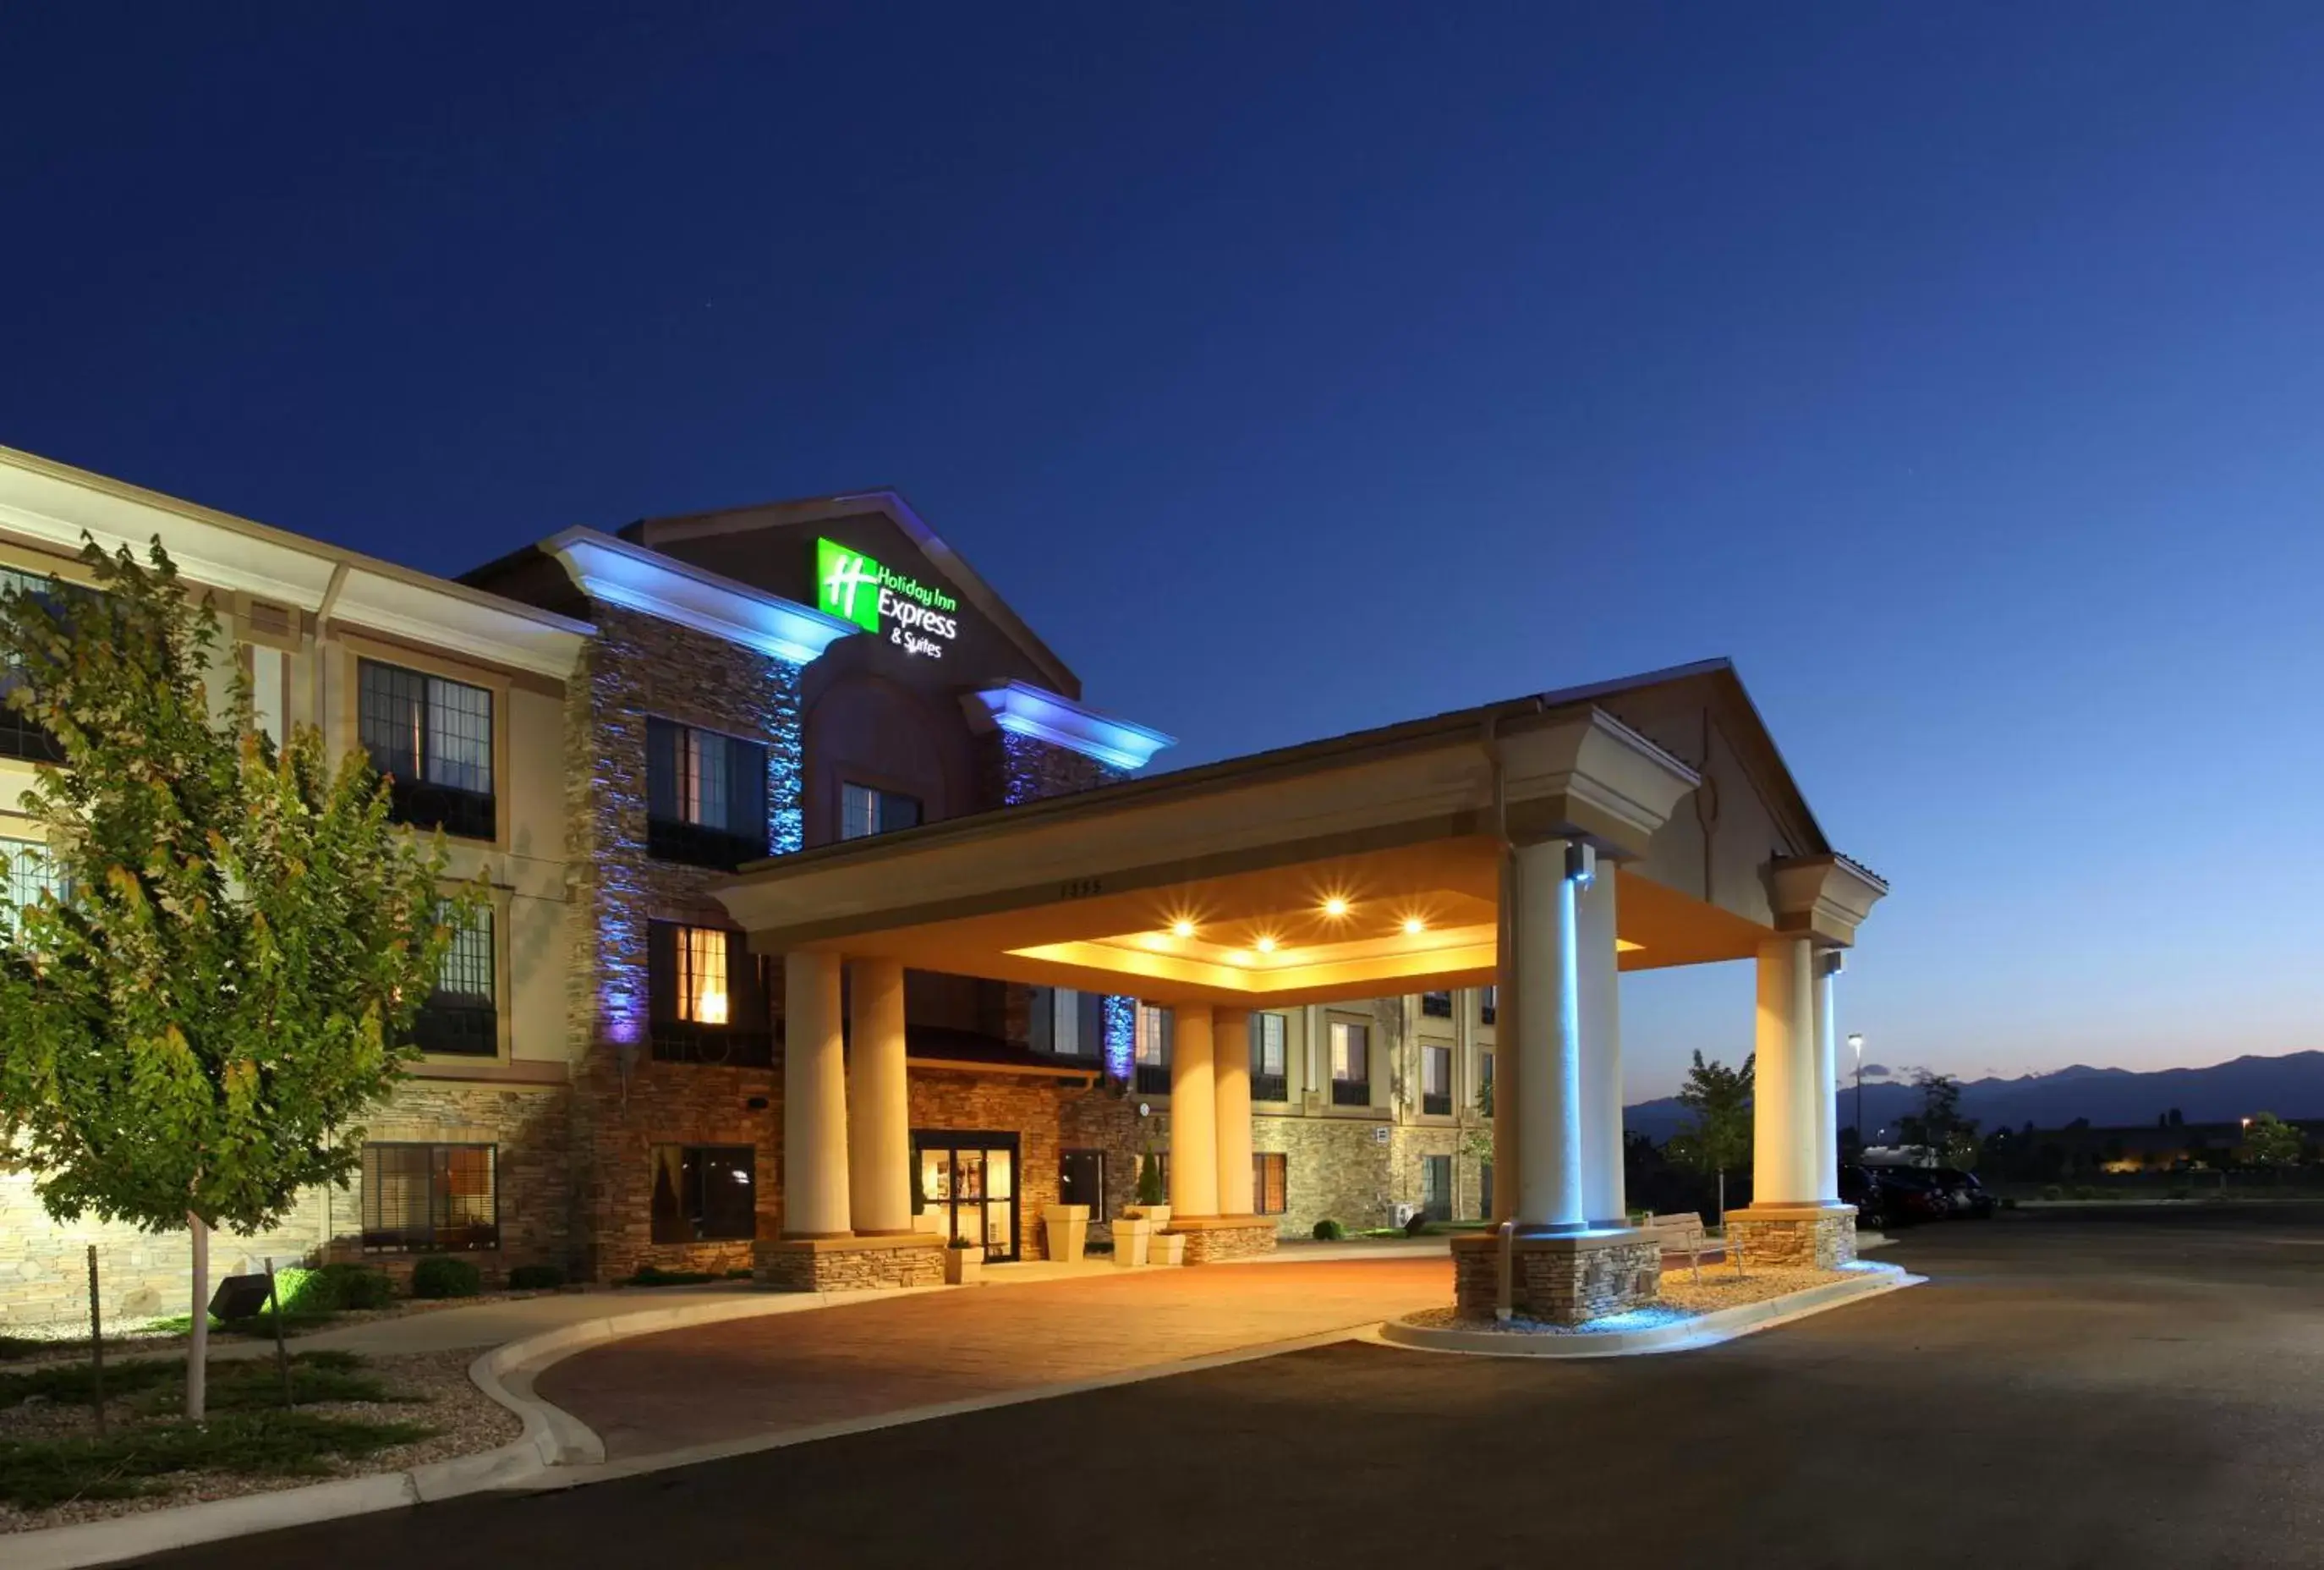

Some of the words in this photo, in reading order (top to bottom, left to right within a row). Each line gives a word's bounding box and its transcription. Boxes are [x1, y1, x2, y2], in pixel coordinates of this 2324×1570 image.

[879, 566, 932, 606] Holiday
[934, 588, 956, 612] Inn
[879, 587, 956, 640] Express
[891, 628, 902, 644] &
[904, 631, 941, 658] Suites
